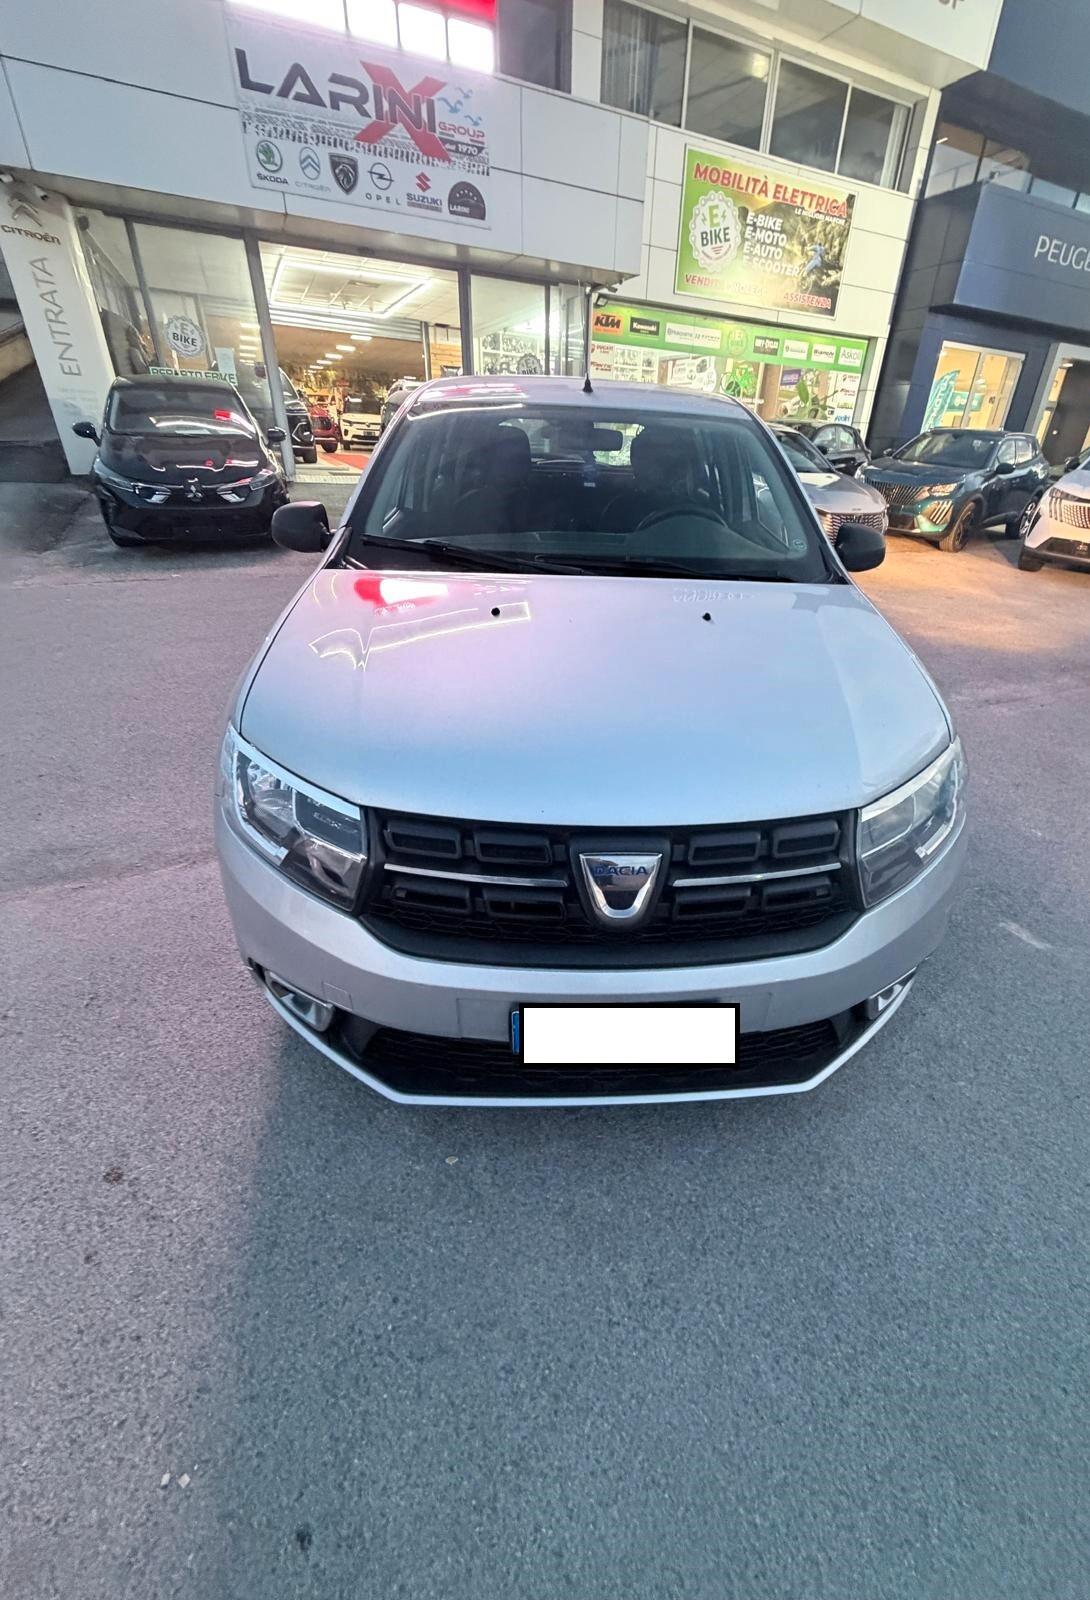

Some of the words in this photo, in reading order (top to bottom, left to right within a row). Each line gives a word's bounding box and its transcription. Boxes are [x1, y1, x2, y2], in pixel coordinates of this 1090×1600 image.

[234, 48, 437, 133] LARINI
[438, 121, 485, 138] GROUP
[458, 144, 479, 155] 1970
[693, 162, 769, 197] MOBILITÀ
[772, 183, 848, 218] ELETTRICA
[365, 192, 401, 206] OPEL
[406, 192, 443, 206] SUZUKI
[708, 204, 721, 228] E
[700, 226, 731, 248] BIKE
[29, 257, 82, 377] ENTRATA
[594, 313, 622, 329] KTM
[172, 332, 198, 347] BIKE
[595, 865, 649, 876] DACIA
